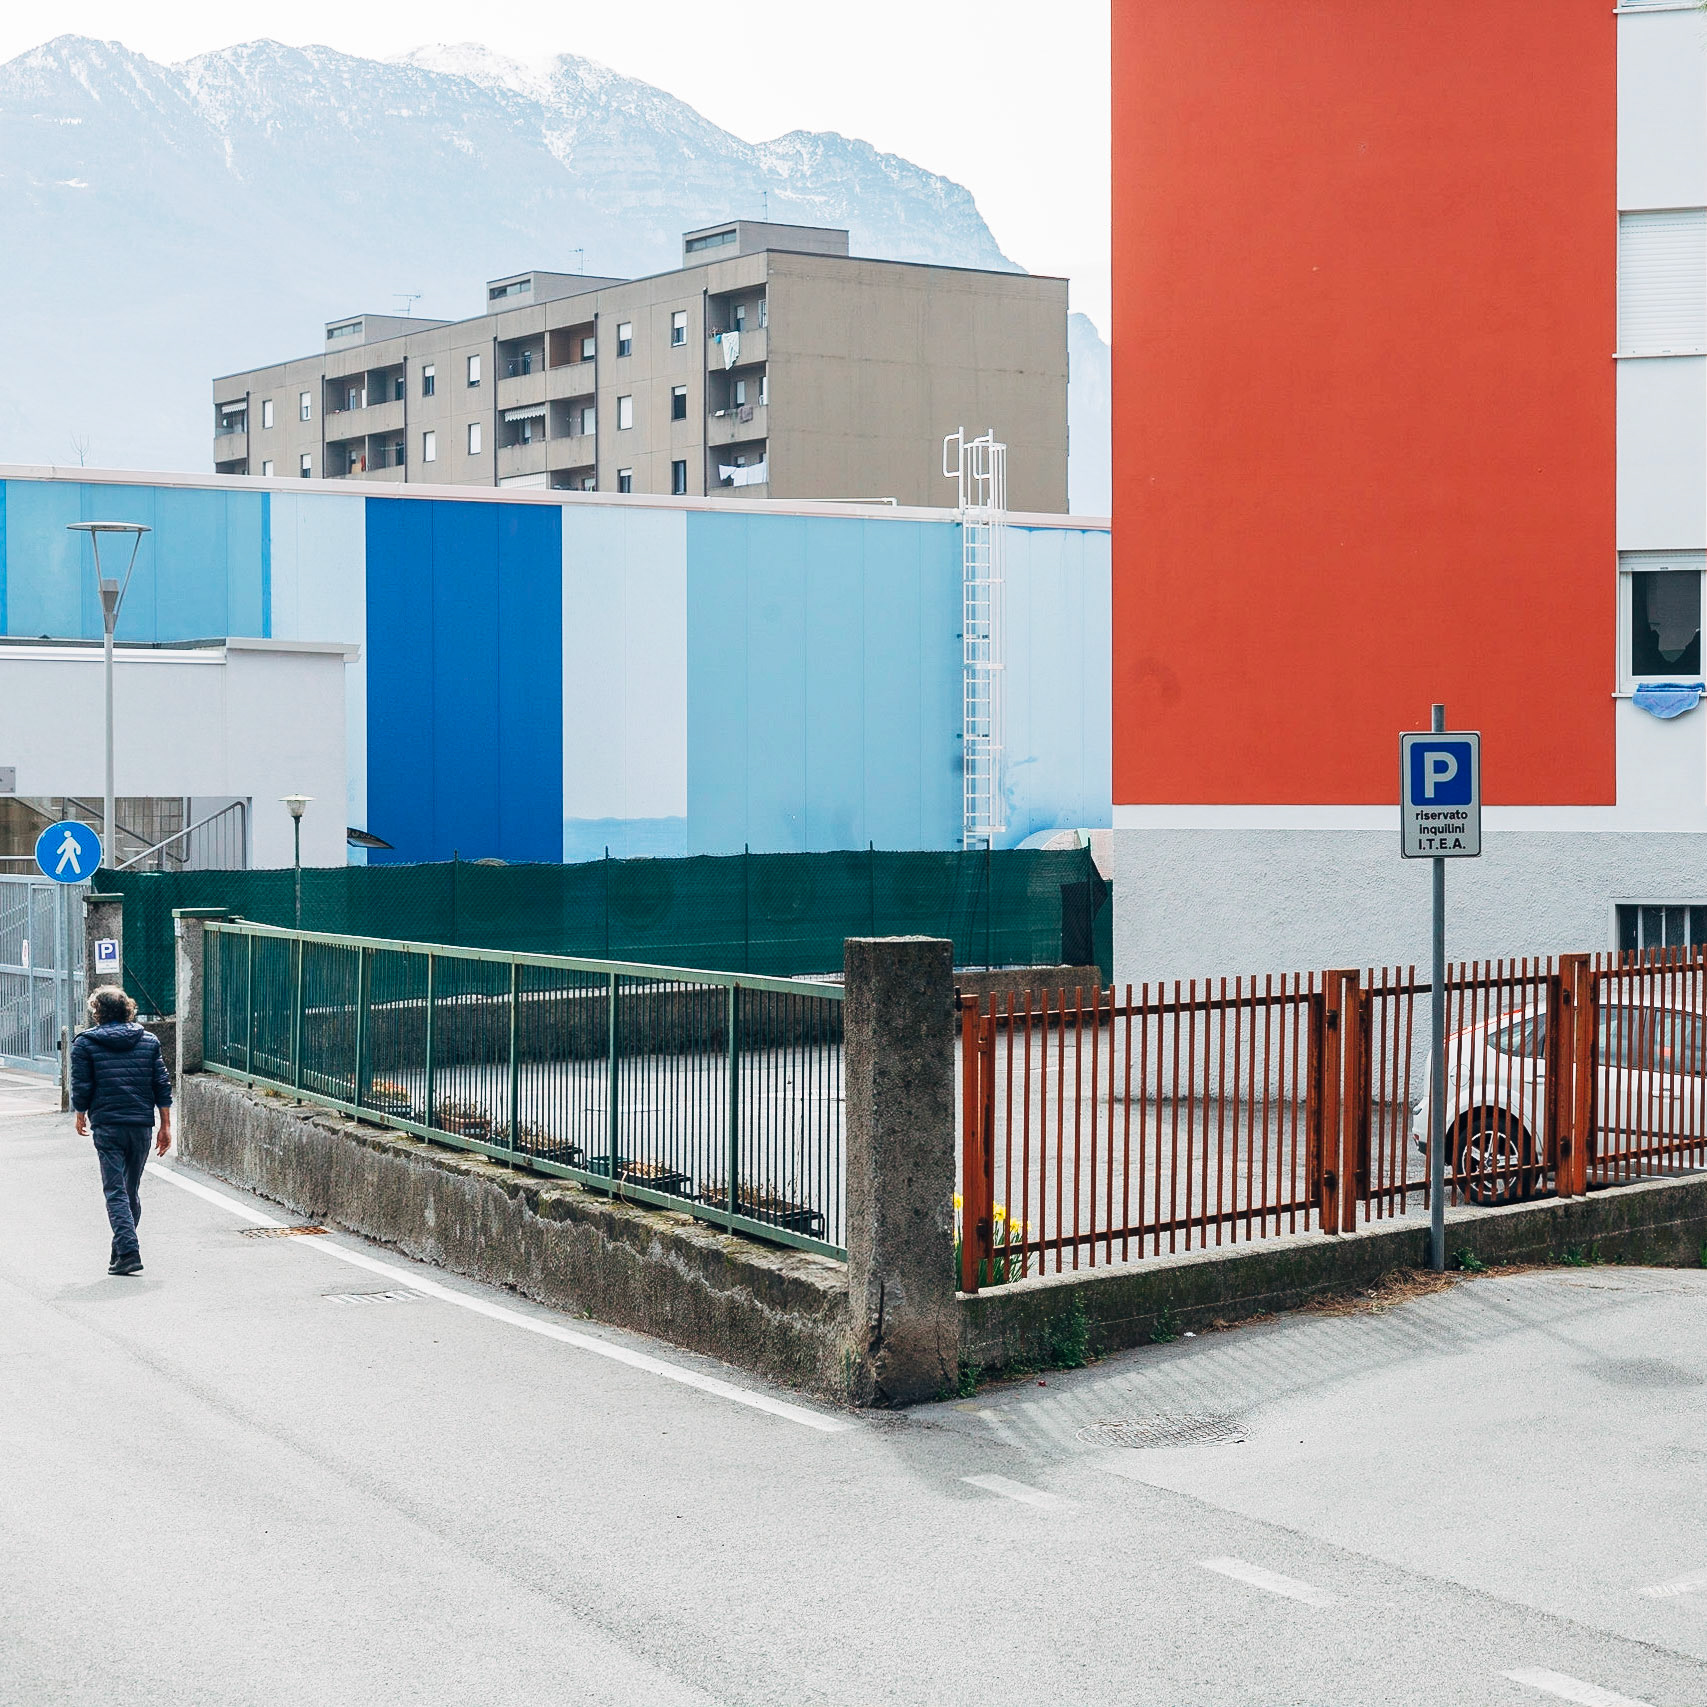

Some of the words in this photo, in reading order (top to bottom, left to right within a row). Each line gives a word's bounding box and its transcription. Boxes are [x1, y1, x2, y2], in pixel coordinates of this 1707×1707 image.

[1424, 752, 1458, 798] P
[1415, 810, 1468, 820] riservato
[1419, 824, 1465, 835] inquilini
[1418, 838, 1466, 850] I.T.E.A.
[101, 943, 113, 959] P
